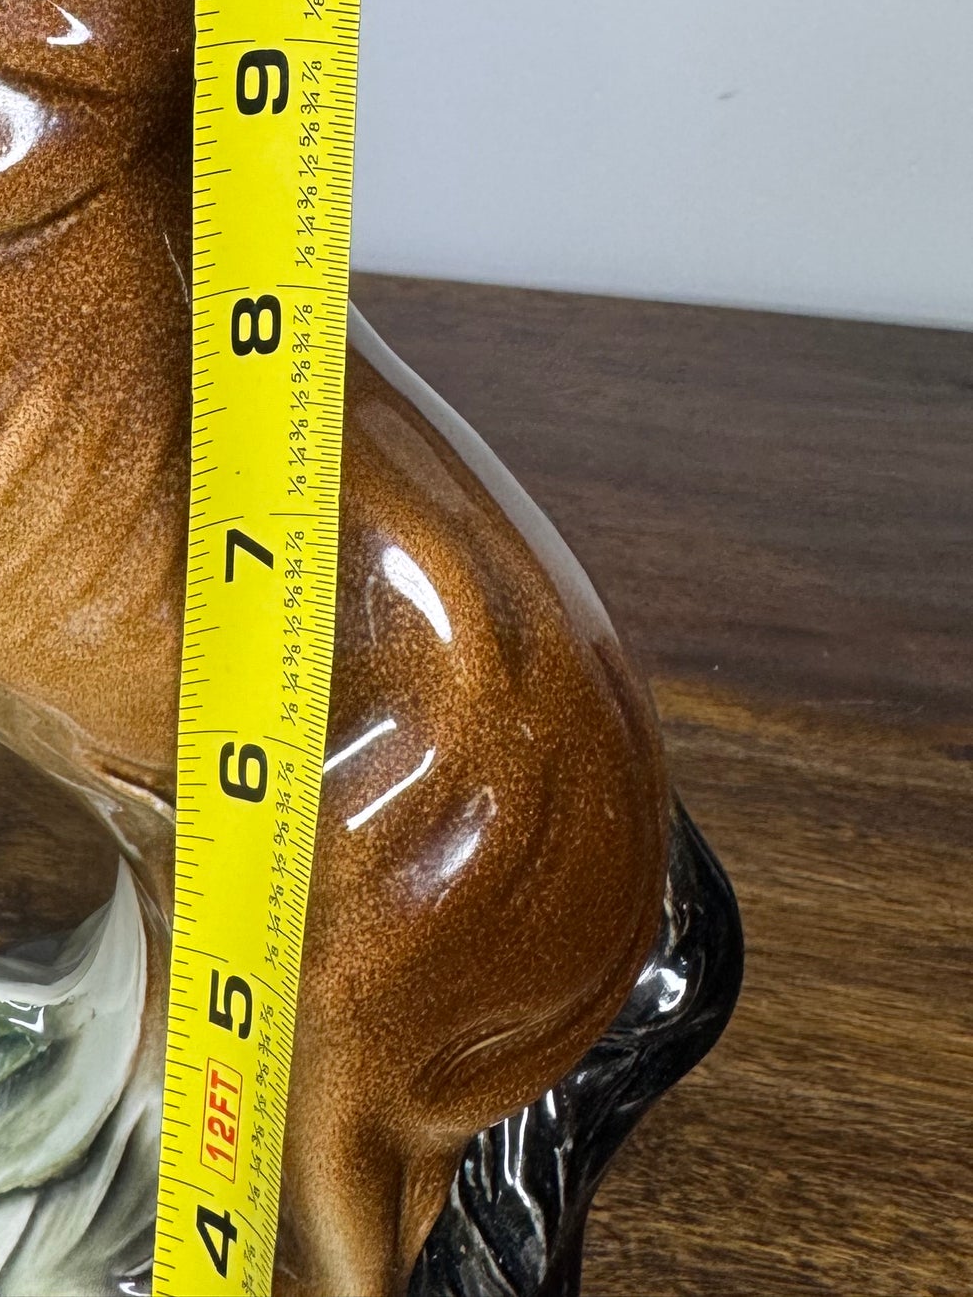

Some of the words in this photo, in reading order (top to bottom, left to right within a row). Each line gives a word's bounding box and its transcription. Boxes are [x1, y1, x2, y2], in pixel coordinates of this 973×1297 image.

[236, 49, 290, 114] 9
[231, 294, 282, 356] 8
[225, 528, 274, 582] 7
[219, 741, 268, 803] 6
[209, 968, 253, 1040] 5
[206, 1070, 239, 1164] 12FT
[196, 1204, 238, 1279] 4
